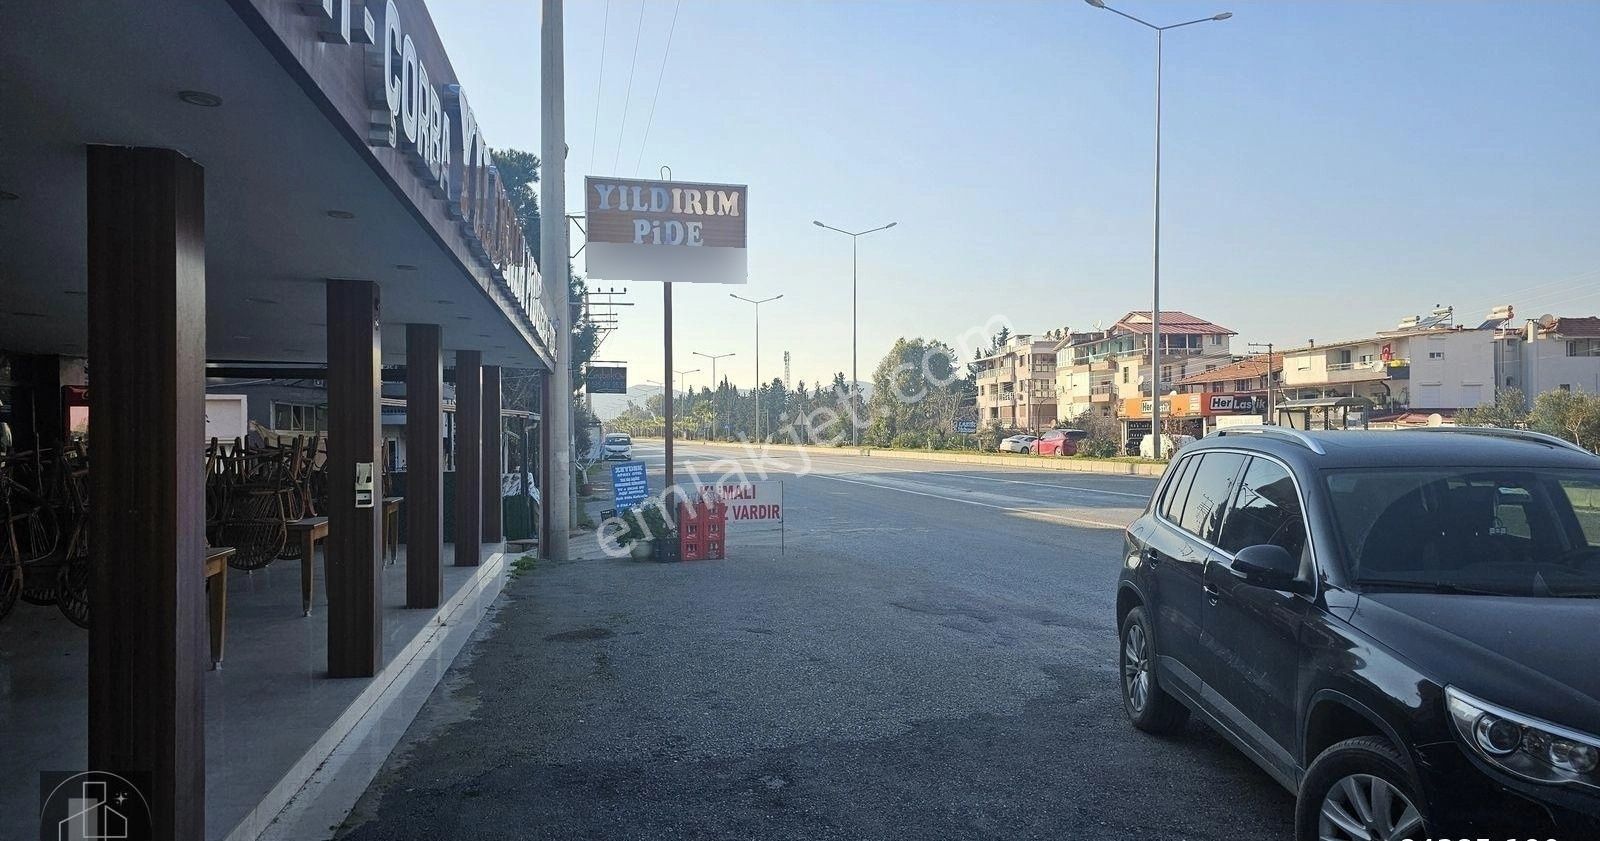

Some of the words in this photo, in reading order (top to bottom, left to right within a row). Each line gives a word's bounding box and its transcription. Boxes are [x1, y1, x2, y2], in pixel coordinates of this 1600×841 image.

[384, 0, 451, 191] ÇORBA
[594, 183, 740, 217] YILDIRIM
[732, 504, 780, 520] VARDIR
